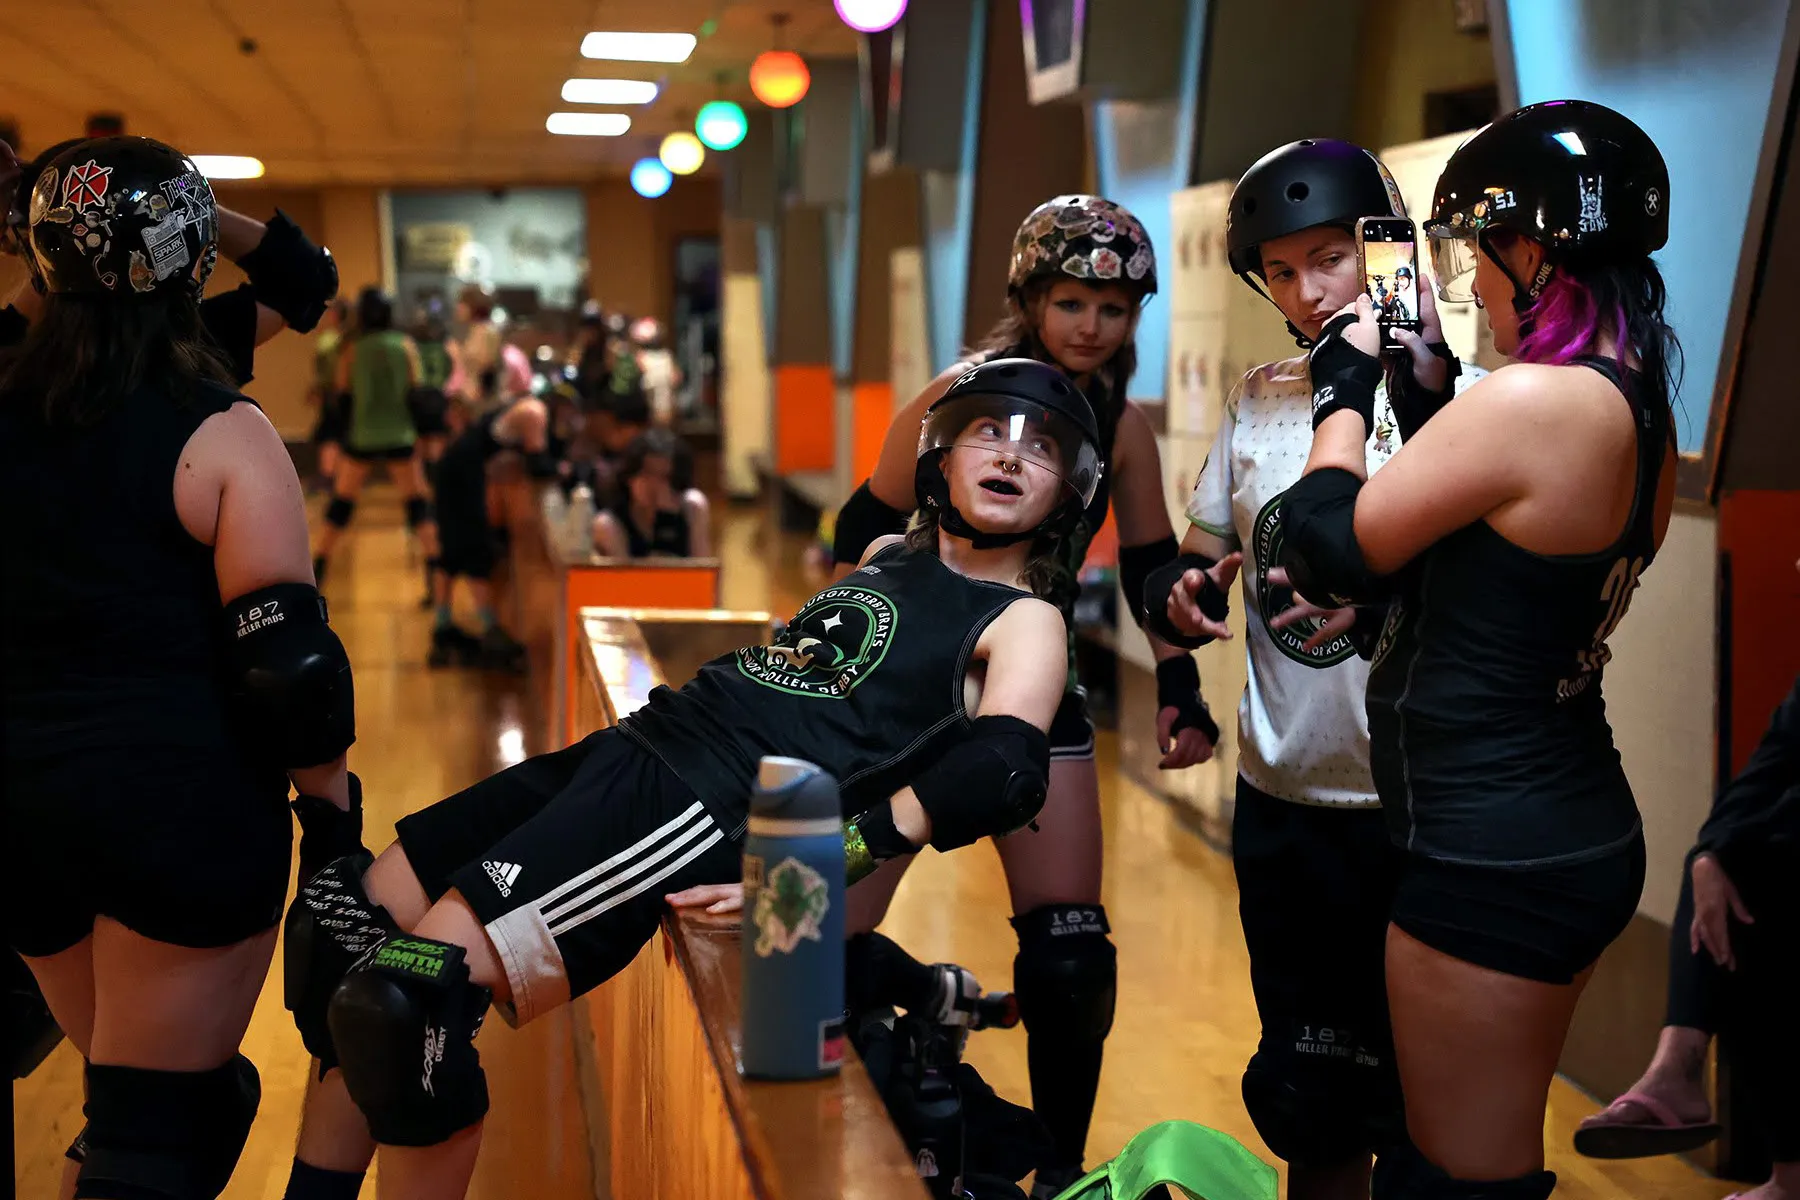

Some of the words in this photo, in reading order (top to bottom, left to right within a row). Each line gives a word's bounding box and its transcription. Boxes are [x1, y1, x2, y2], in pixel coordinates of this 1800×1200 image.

[154, 238, 182, 258] SPARK
[1313, 386, 1333, 407] 87
[237, 621, 262, 638] KILLER
[262, 612, 285, 627] PADS
[238, 600, 279, 627] 187
[852, 593, 888, 614] DERBY
[872, 612, 890, 647] BRATS
[1282, 632, 1324, 657] JUNOR
[819, 664, 859, 696] DERBY
[483, 860, 512, 898] adidas
[1052, 909, 1097, 926] 187
[377, 947, 445, 971] SMITH
[411, 965, 439, 978] GEAR
[434, 1026, 447, 1063] DERBY
[1295, 1041, 1329, 1055] KILLER
